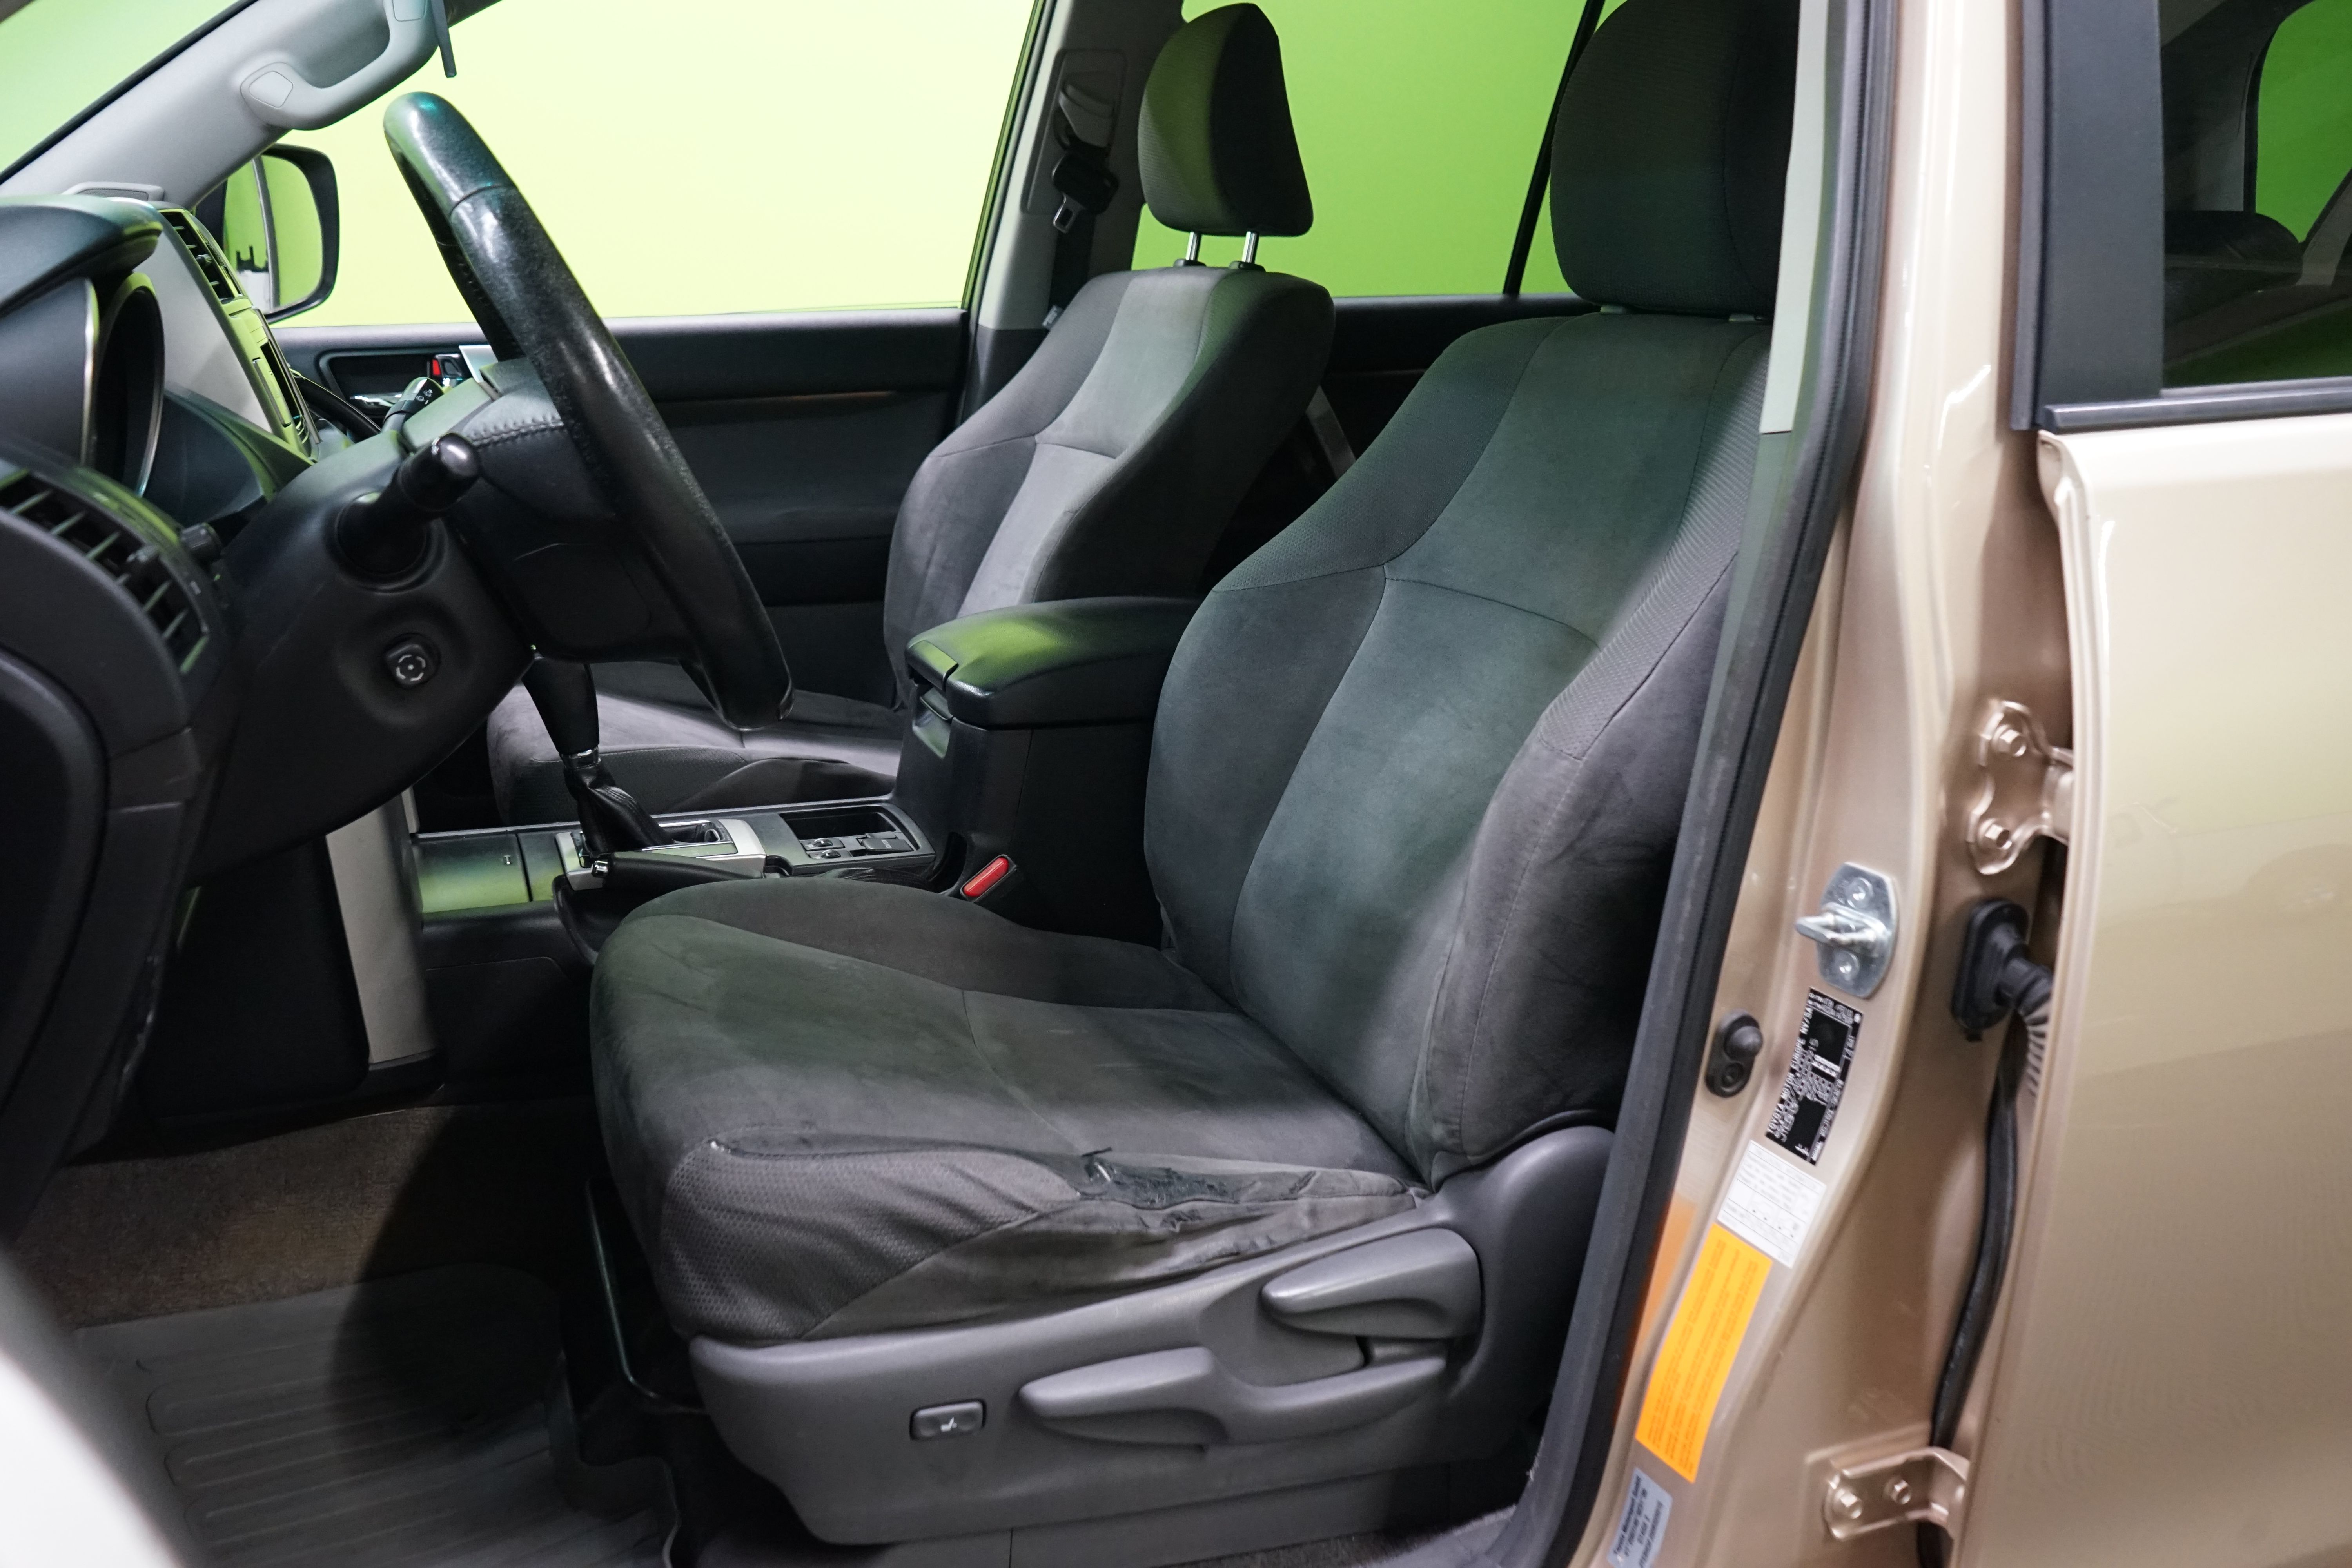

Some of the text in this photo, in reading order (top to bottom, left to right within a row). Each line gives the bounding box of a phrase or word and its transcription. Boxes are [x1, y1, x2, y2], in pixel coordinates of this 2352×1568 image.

[1767, 1007, 1813, 1133] TOYOTA MOTOR EUROPE NV/SA
